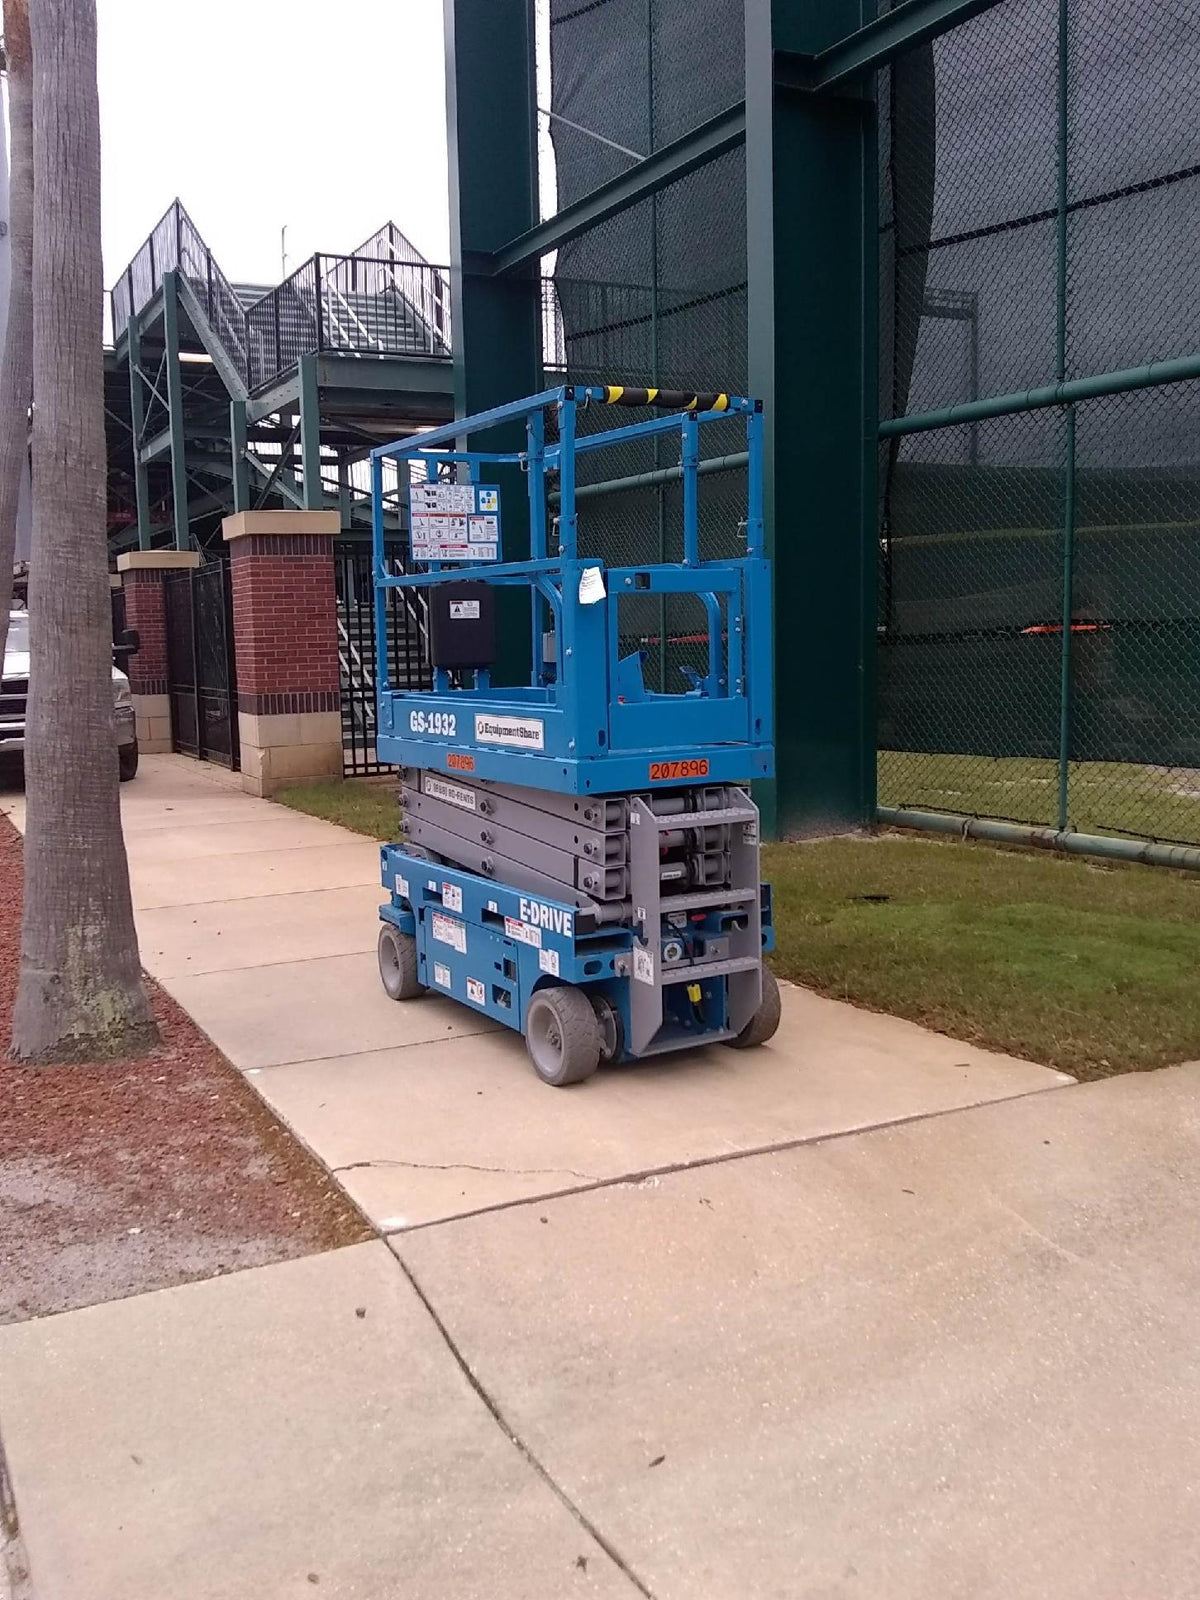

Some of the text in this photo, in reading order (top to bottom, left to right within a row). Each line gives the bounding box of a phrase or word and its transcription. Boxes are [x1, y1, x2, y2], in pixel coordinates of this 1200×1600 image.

[410, 710, 456, 737] GS-1932
[484, 723, 540, 740] EquipmentShare
[448, 753, 474, 770] 207896
[651, 759, 708, 780] 207896
[519, 897, 573, 939] E-DRIVE
